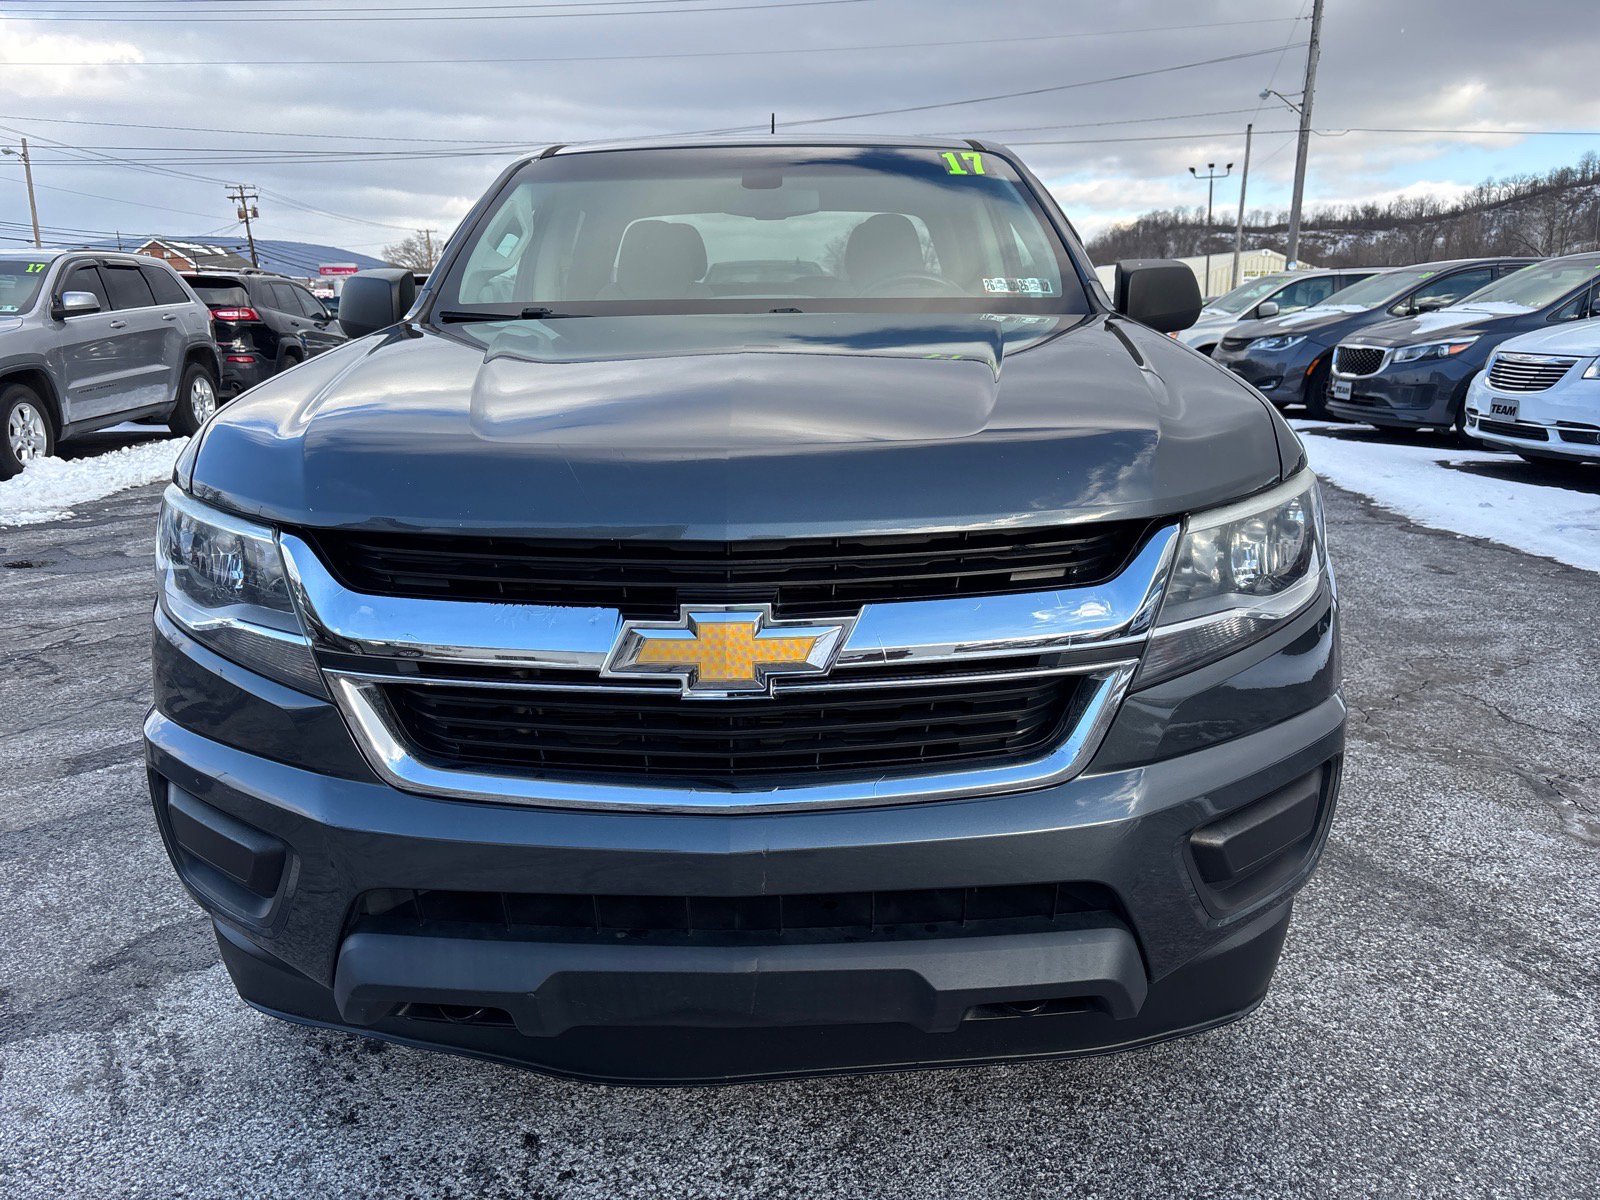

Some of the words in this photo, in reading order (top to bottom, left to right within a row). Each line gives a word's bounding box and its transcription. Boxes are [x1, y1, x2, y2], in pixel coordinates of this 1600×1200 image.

[941, 152, 985, 175] 17
[25, 263, 46, 273] 17
[1491, 403, 1517, 417] TEAM
